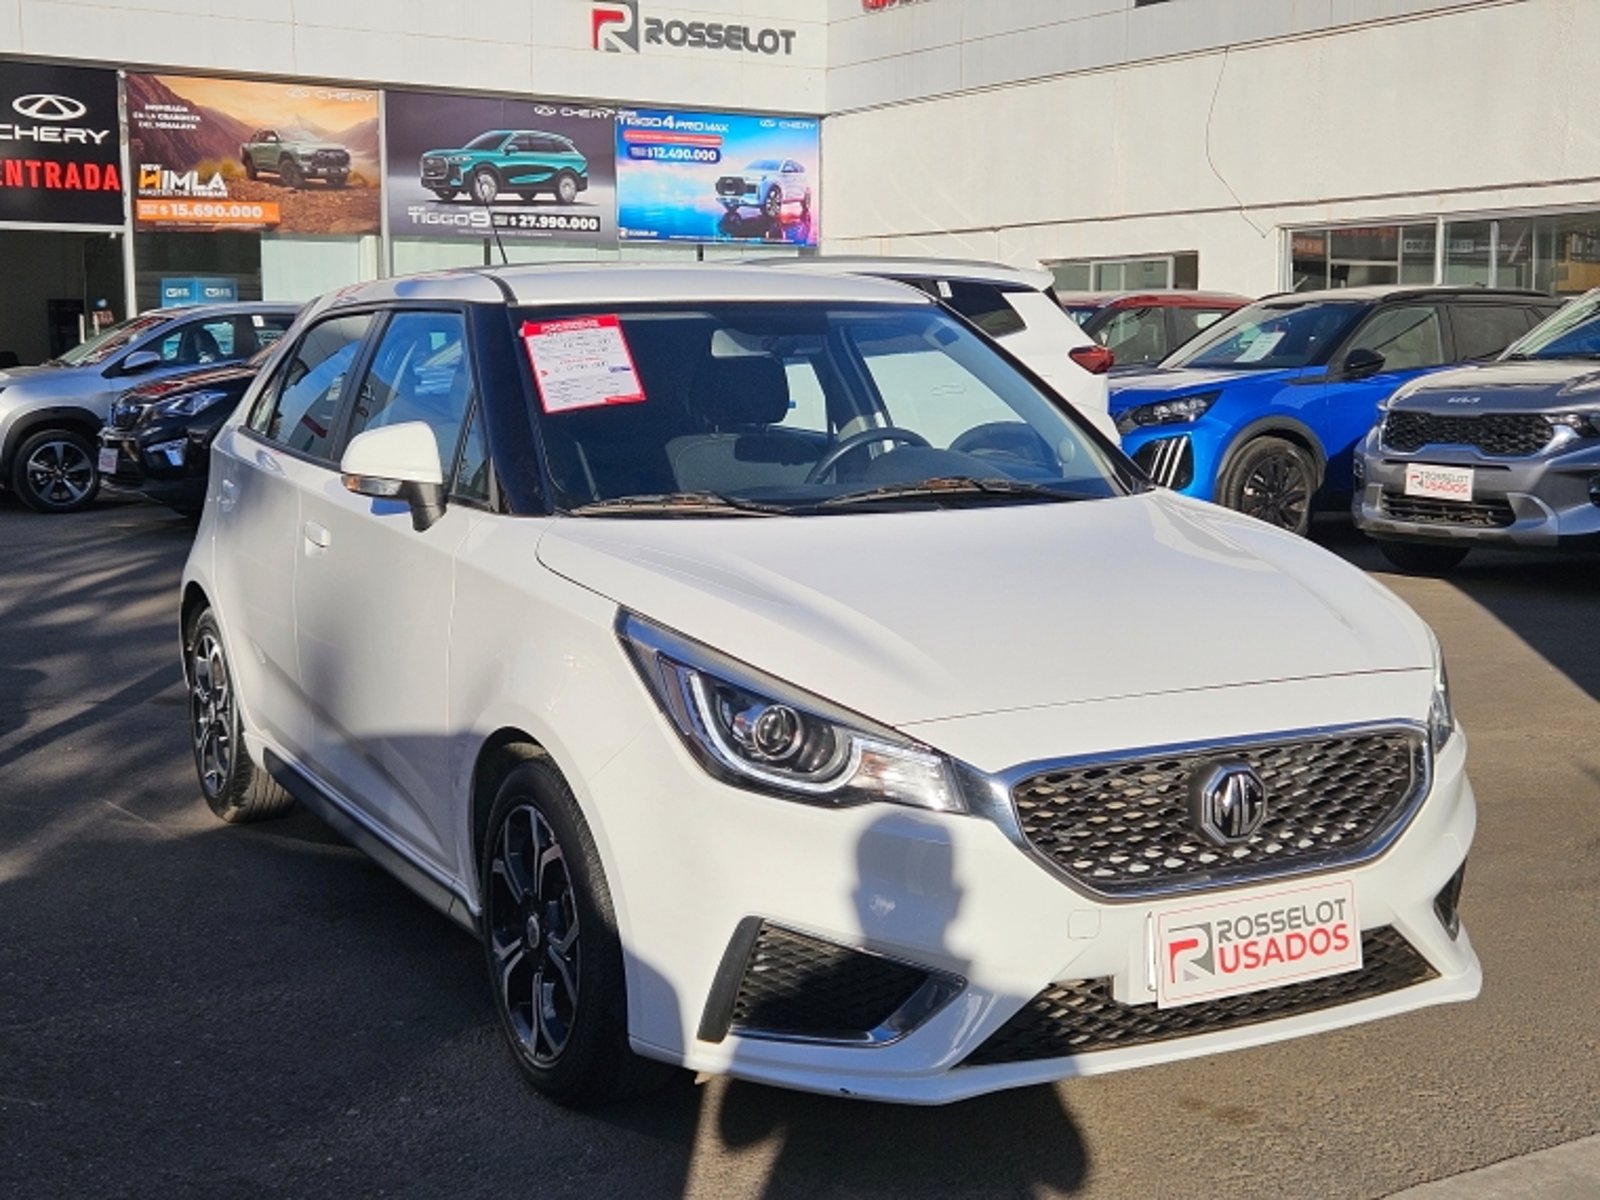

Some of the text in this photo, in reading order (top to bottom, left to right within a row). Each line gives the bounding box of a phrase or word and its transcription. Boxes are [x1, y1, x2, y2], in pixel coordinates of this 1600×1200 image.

[644, 17, 796, 54] ROSSELOT
[0, 159, 120, 190] NTRADA
[139, 169, 228, 190] HIMLA
[170, 203, 263, 218] 15.690.000
[518, 215, 598, 231] 27.990.000
[1216, 898, 1347, 944] ROSSELOT
[1218, 923, 1350, 974] USADOS
